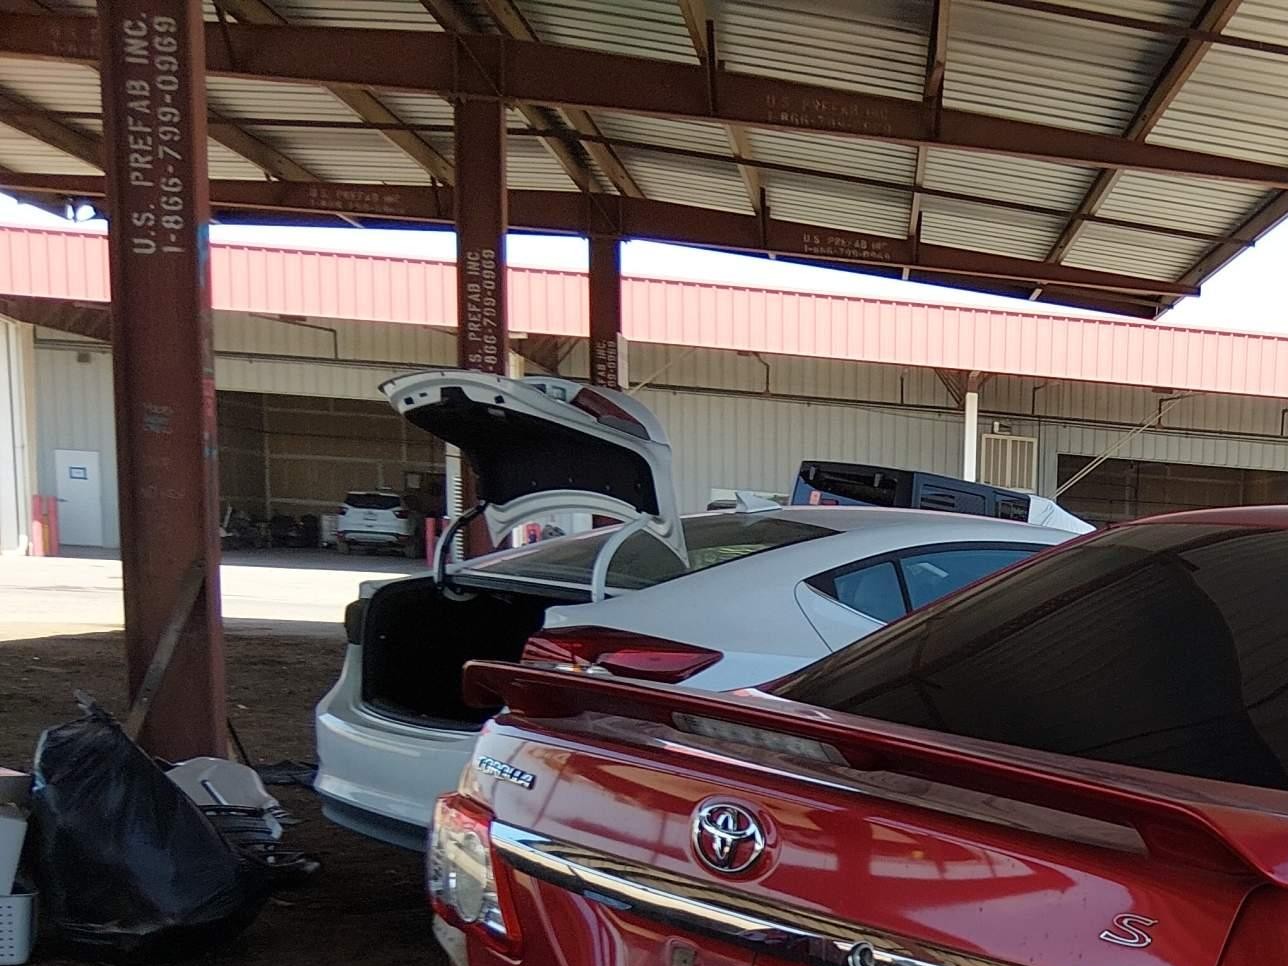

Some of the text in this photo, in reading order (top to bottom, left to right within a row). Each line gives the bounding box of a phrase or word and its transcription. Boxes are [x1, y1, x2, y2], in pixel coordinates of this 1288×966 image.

[123, 12, 156, 255] U.S. PREFAB INC.
[153, 15, 184, 254] 1-866-799-0969
[466, 282, 482, 341] PREFAB
[1099, 912, 1158, 948] S
